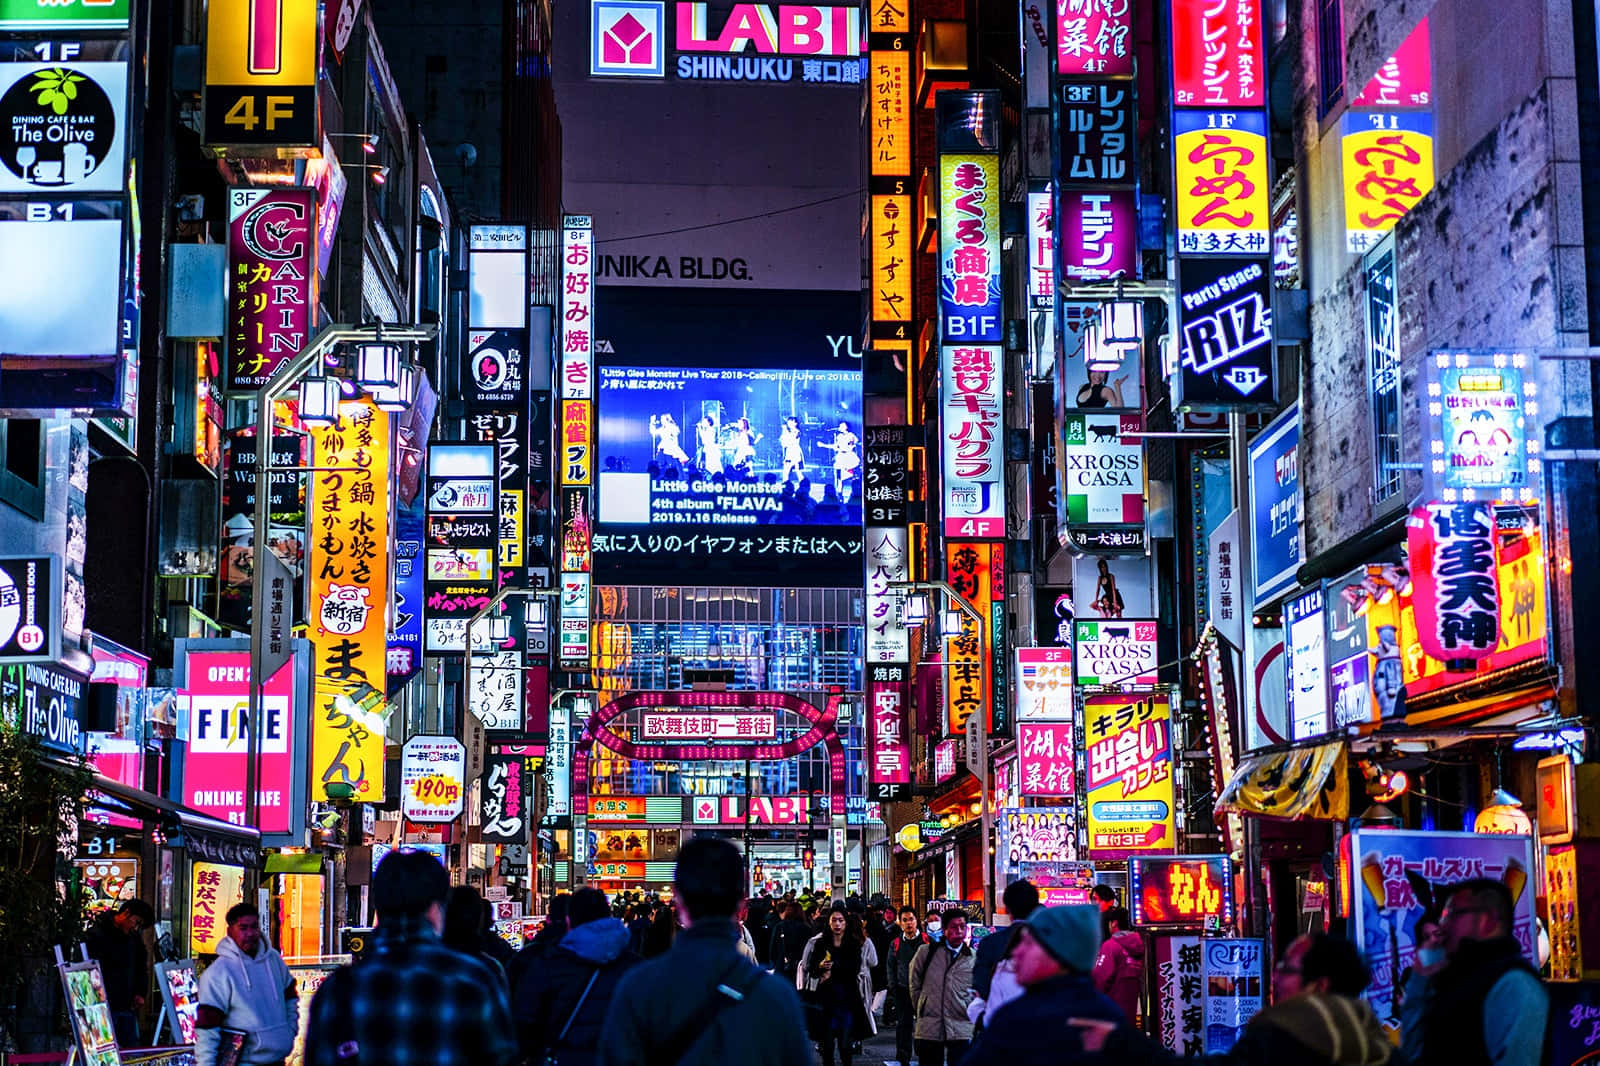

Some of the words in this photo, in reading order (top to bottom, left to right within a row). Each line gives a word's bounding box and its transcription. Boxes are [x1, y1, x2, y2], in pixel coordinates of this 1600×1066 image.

[874, 1, 904, 27] 金
[676, 2, 861, 56] LABI
[34, 42, 81, 61] 1F
[893, 38, 902, 50] 6
[676, 56, 793, 81] SHINJUKU
[802, 60, 860, 84] 東口館
[1083, 58, 1108, 72] 4F
[1238, 54, 1254, 98] ホステル
[1068, 87, 1093, 102] 3F
[1177, 89, 1194, 102] 2F
[12, 116, 45, 125] DINING
[47, 116, 68, 125] CAFE
[70, 116, 77, 125] &
[79, 116, 96, 125] BAR
[223, 96, 295, 131] 4F
[874, 64, 897, 162] ちびすけバル
[1207, 114, 1237, 128] 1F
[12, 125, 42, 143] The
[46, 124, 95, 143] Olive
[1099, 85, 1127, 179] レンタル
[1070, 109, 1096, 178] ルーム
[894, 182, 904, 194] 5
[1188, 134, 1256, 229] らーめん
[232, 193, 258, 207] 3F
[26, 203, 75, 221] B1
[569, 231, 585, 240] 8F
[952, 162, 990, 306] まぐろ商店
[1081, 194, 1114, 268] エデン
[1181, 231, 1266, 251] 博多天神
[678, 256, 754, 281] BLDG.
[879, 223, 904, 318] すずや
[1179, 282, 1220, 311] Party
[1218, 264, 1263, 294] Space
[236, 263, 249, 374] 個室ダイニング
[249, 262, 272, 376] カリーナ
[564, 244, 589, 383] お好み焼き
[895, 326, 905, 338] 4
[947, 315, 996, 336] B1F
[1184, 295, 1266, 373] RIZ
[472, 335, 485, 345] 4F
[700, 370, 720, 379] Tour
[1231, 370, 1254, 383] B1
[568, 388, 584, 397] 7F
[947, 347, 999, 478] 熟女キャバクラ
[1068, 420, 1079, 433] 肉
[1067, 454, 1138, 470] XROSS
[866, 450, 880, 501] いろは
[1075, 471, 1131, 487] CASA
[651, 480, 688, 494] Little
[726, 480, 787, 494] Monster
[462, 493, 488, 507] 酔月
[651, 498, 674, 510] 4th
[675, 498, 714, 510] album
[951, 493, 977, 503] mrs
[712, 513, 758, 524] Release
[872, 508, 901, 521] 3F
[960, 519, 991, 537] 4F
[348, 511, 377, 583] 水炊き
[27, 561, 37, 587] FOOD
[1218, 542, 1233, 620] 劇場通り一番街
[871, 565, 892, 636] バンタイ
[269, 576, 284, 655] 劇場通り一番街
[323, 600, 365, 633] 新宿の
[22, 632, 39, 644] B1
[879, 651, 896, 661] 3F
[1045, 651, 1062, 661] 2F
[1083, 643, 1152, 659] XROSS
[208, 667, 245, 682] OPEN
[873, 667, 903, 681] 焼肉
[1092, 659, 1147, 675] CASA
[26, 663, 50, 689] DINING
[50, 672, 66, 692] CAFE
[69, 679, 81, 700] BAR
[497, 652, 518, 713] 居酒屋
[25, 685, 47, 739] The
[48, 695, 80, 746] Olive
[1091, 696, 1155, 738] キラリ
[647, 717, 772, 734] 歌舞伎町一番街
[875, 690, 902, 776] 安楽亭
[1091, 718, 1166, 784] 出会い
[416, 779, 458, 800] 190円
[1122, 761, 1169, 799] カフェ
[193, 791, 244, 807] ONLINE
[254, 791, 281, 807] AFE
[879, 783, 900, 798] 2F
[594, 799, 629, 812] 吉野家
[721, 797, 810, 824] LABI
[87, 837, 116, 855] B1
[1096, 834, 1146, 847] 受付3F
[1384, 858, 1504, 879] ガールズバー
[1228, 944, 1259, 970] Fiji
